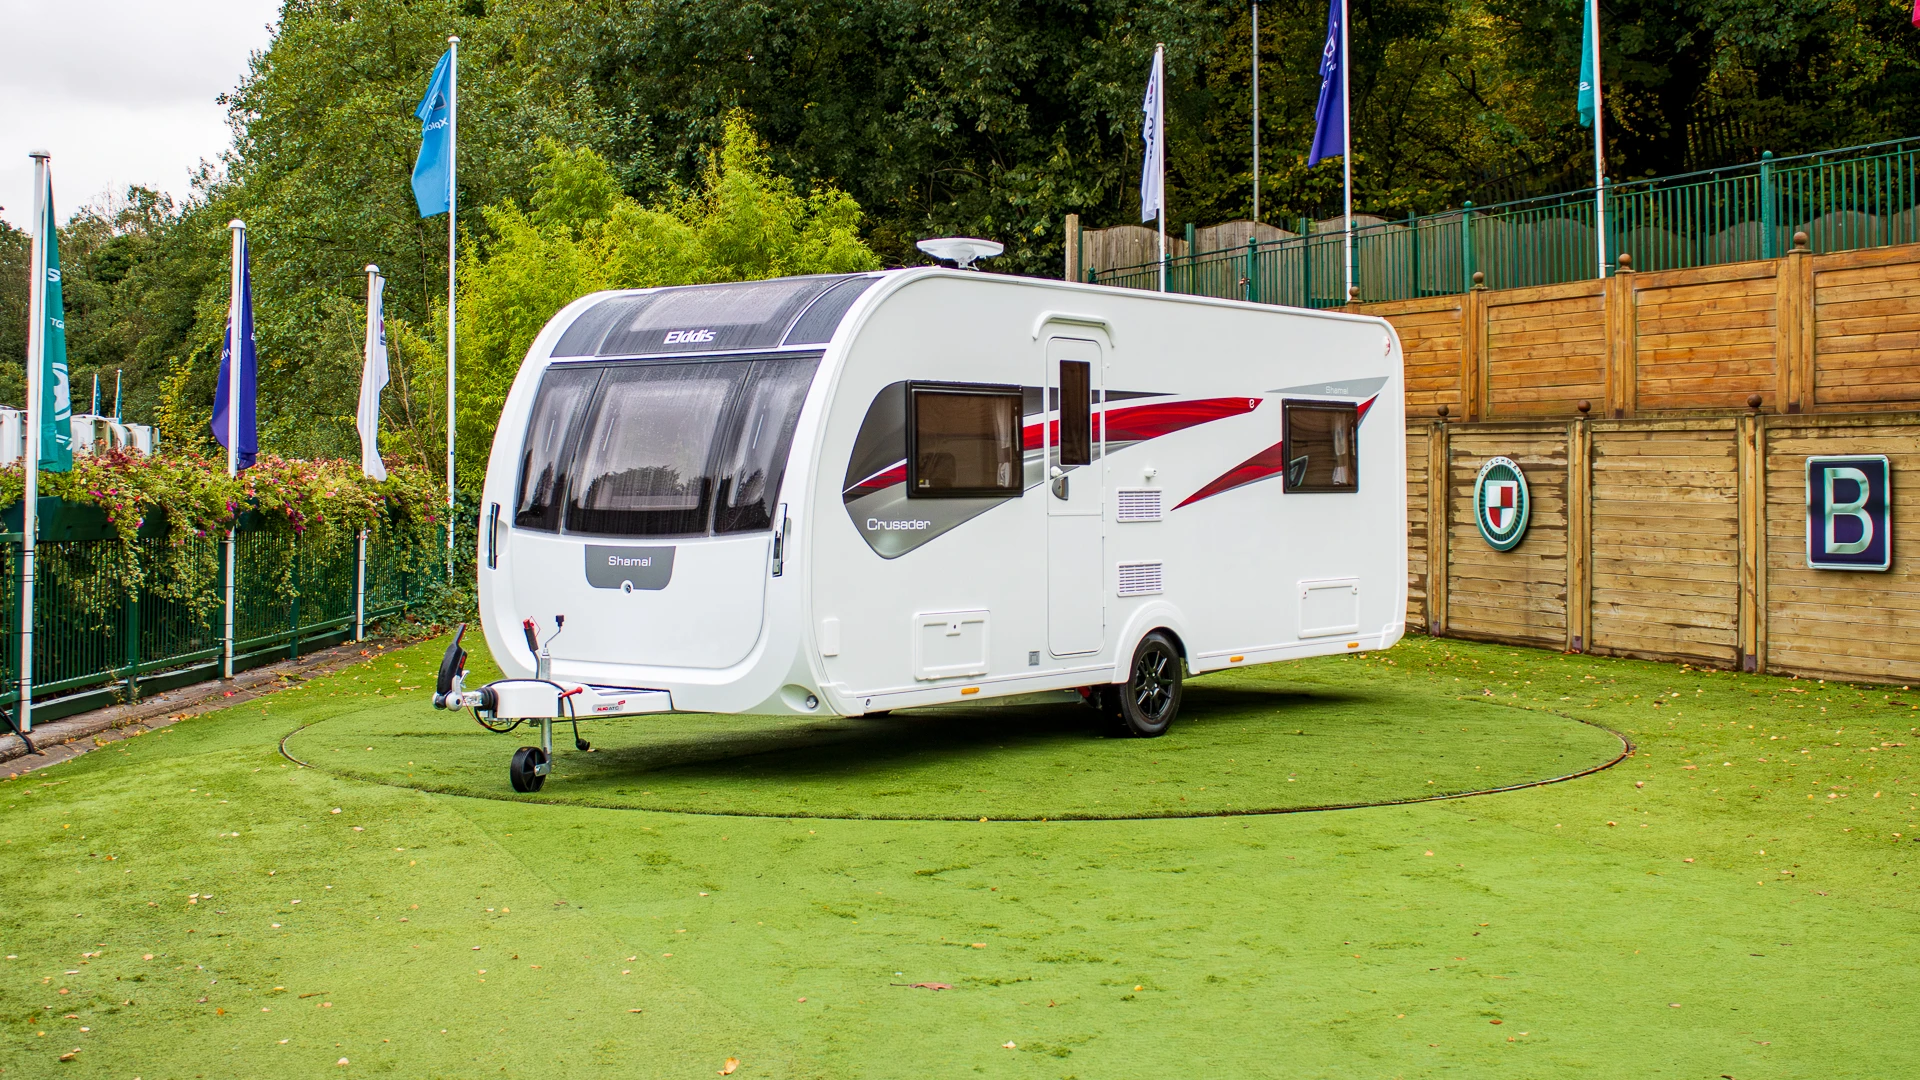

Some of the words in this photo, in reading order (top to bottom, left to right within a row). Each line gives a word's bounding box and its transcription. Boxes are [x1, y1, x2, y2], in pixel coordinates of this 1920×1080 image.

[663, 329, 717, 345] Elddis
[1325, 385, 1349, 395] Shamal
[1480, 458, 1523, 478] COACHMAN
[1823, 467, 1874, 555] B
[866, 518, 931, 531] Crusader
[608, 555, 652, 567] Shamal
